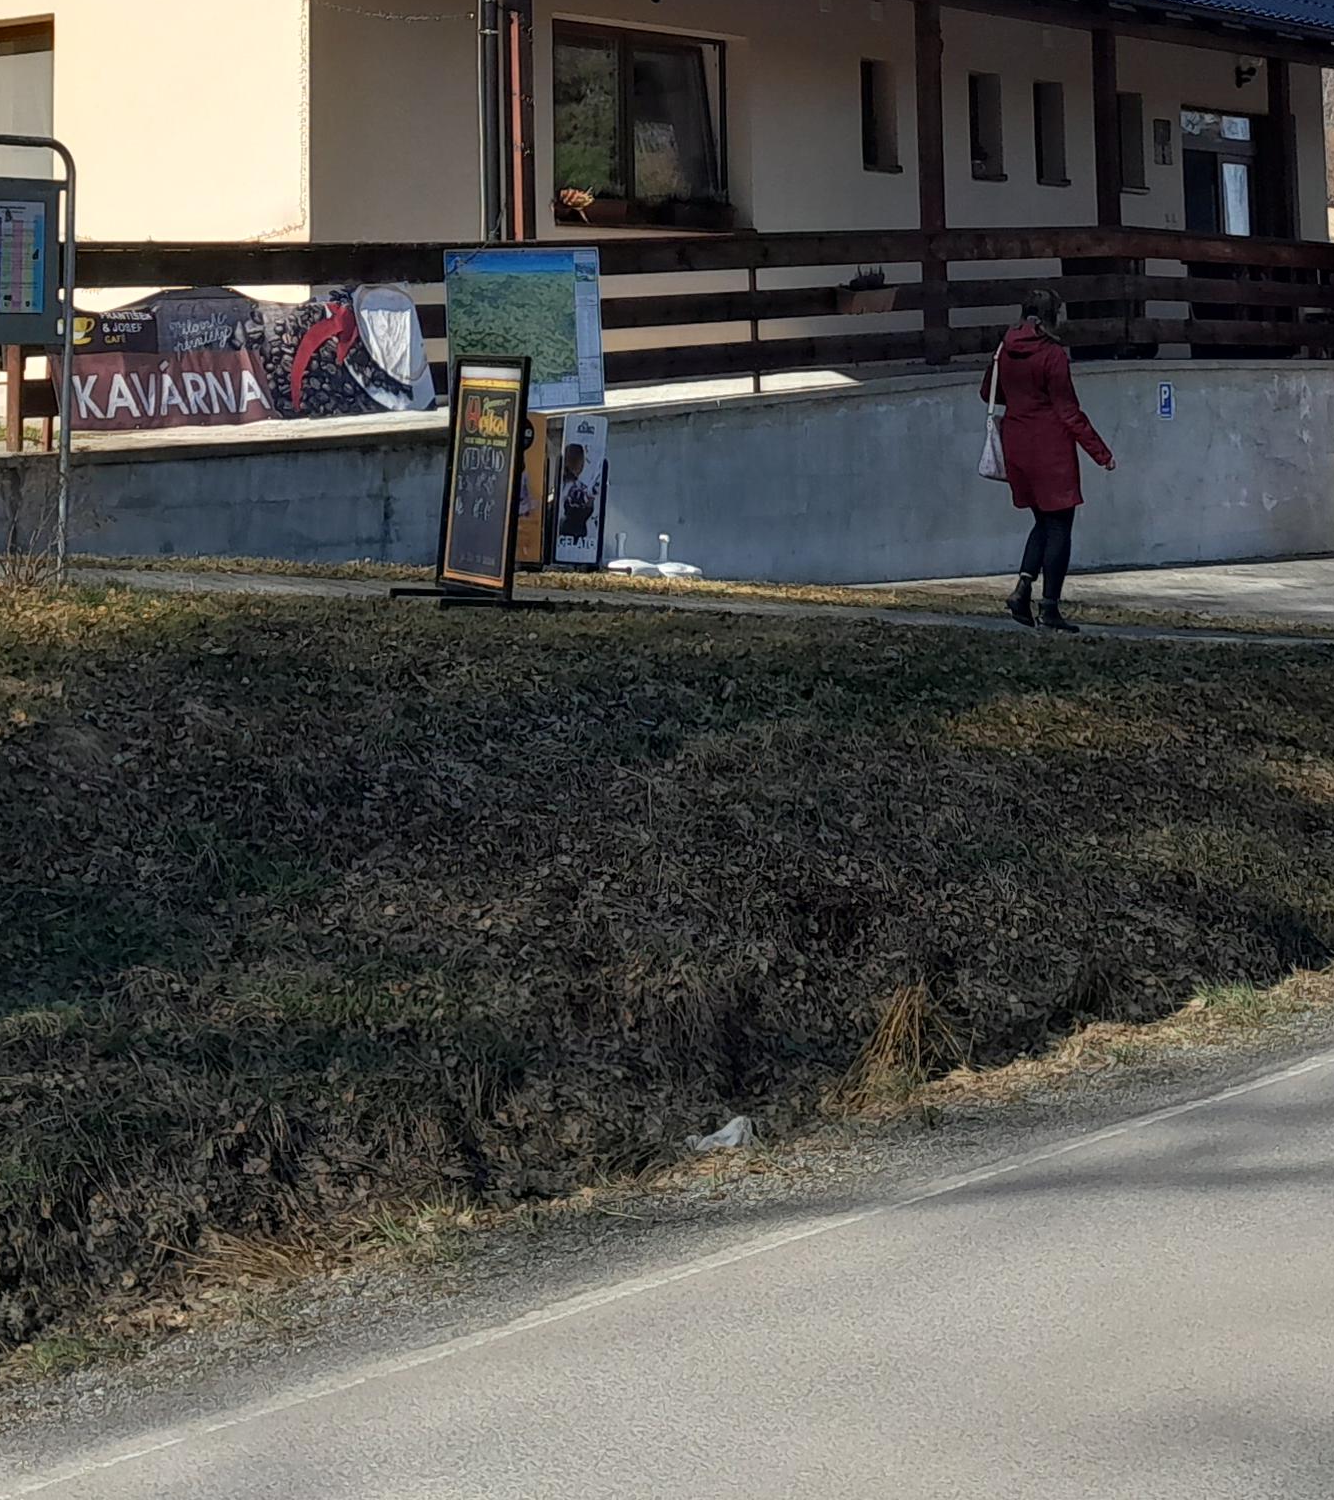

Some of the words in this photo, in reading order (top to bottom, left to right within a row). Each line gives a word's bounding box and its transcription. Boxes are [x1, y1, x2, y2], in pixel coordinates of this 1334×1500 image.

[112, 322, 143, 333] JOSEF
[71, 360, 271, 419] KAVÁRNA
[1161, 385, 1170, 406] P
